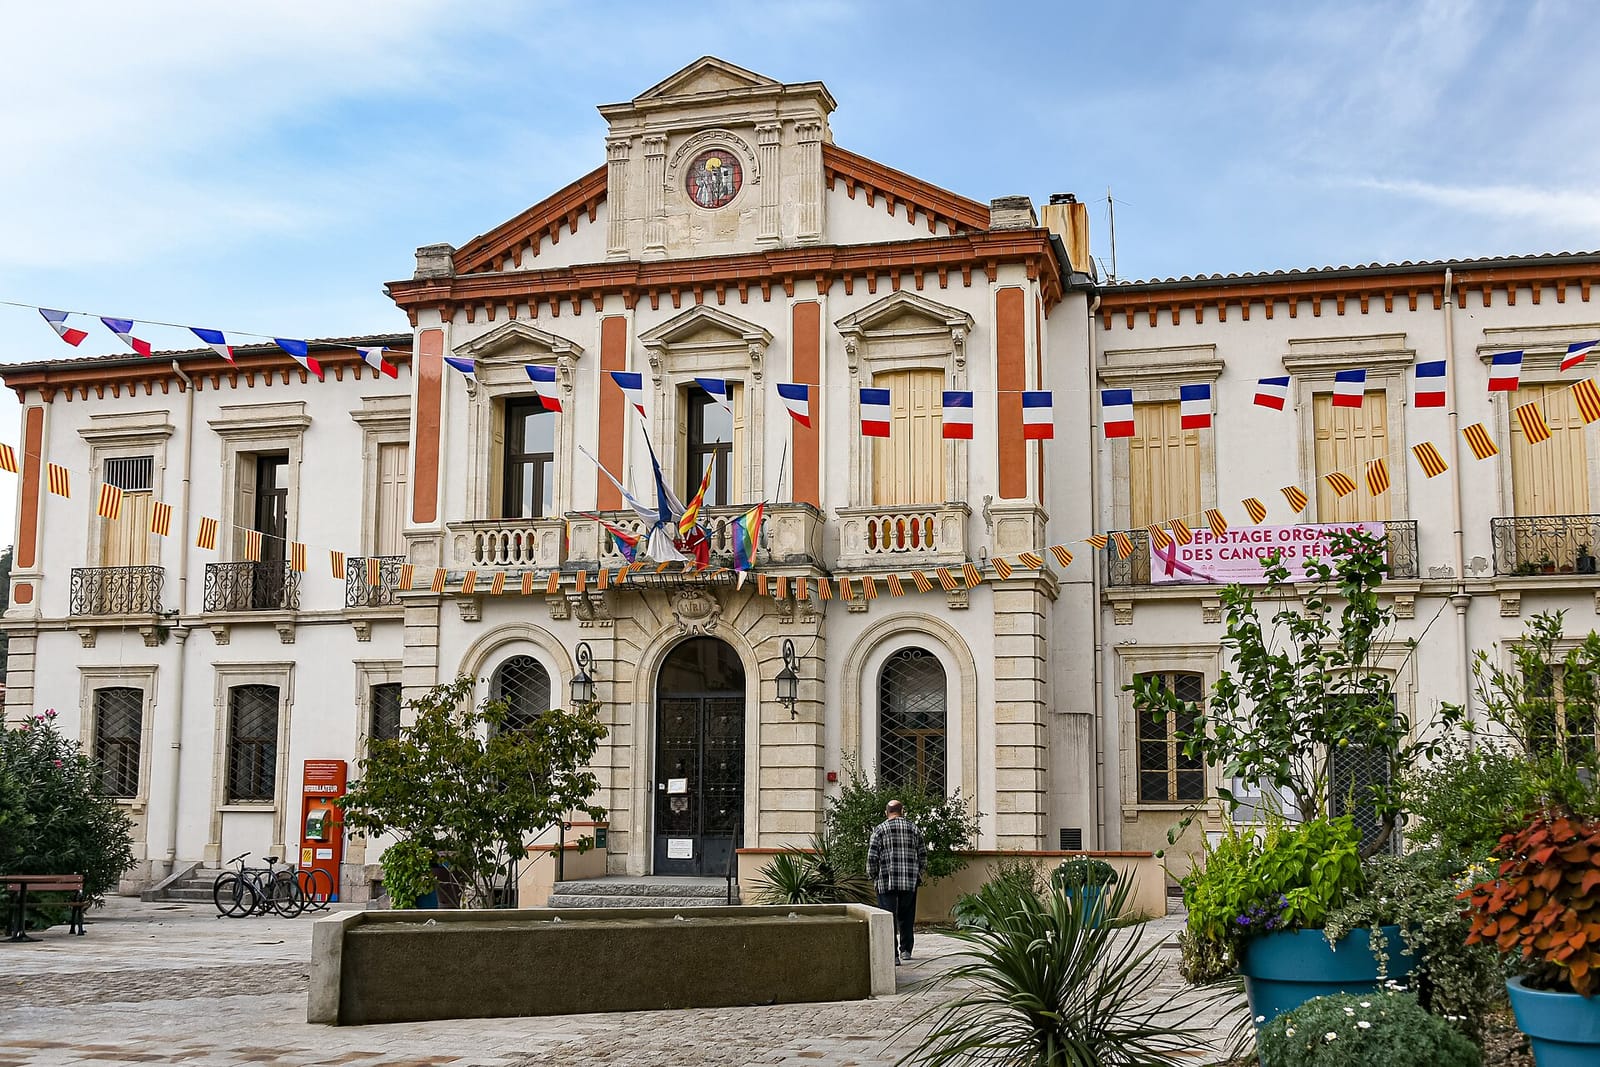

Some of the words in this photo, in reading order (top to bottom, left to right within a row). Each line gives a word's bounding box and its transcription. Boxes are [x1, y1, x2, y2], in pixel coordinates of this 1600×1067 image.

[1183, 530, 1272, 545] ÉPISTAGE
[1278, 524, 1364, 541] ORGANÉ
[1182, 548, 1213, 561] DES
[1219, 546, 1296, 560] CANCERS
